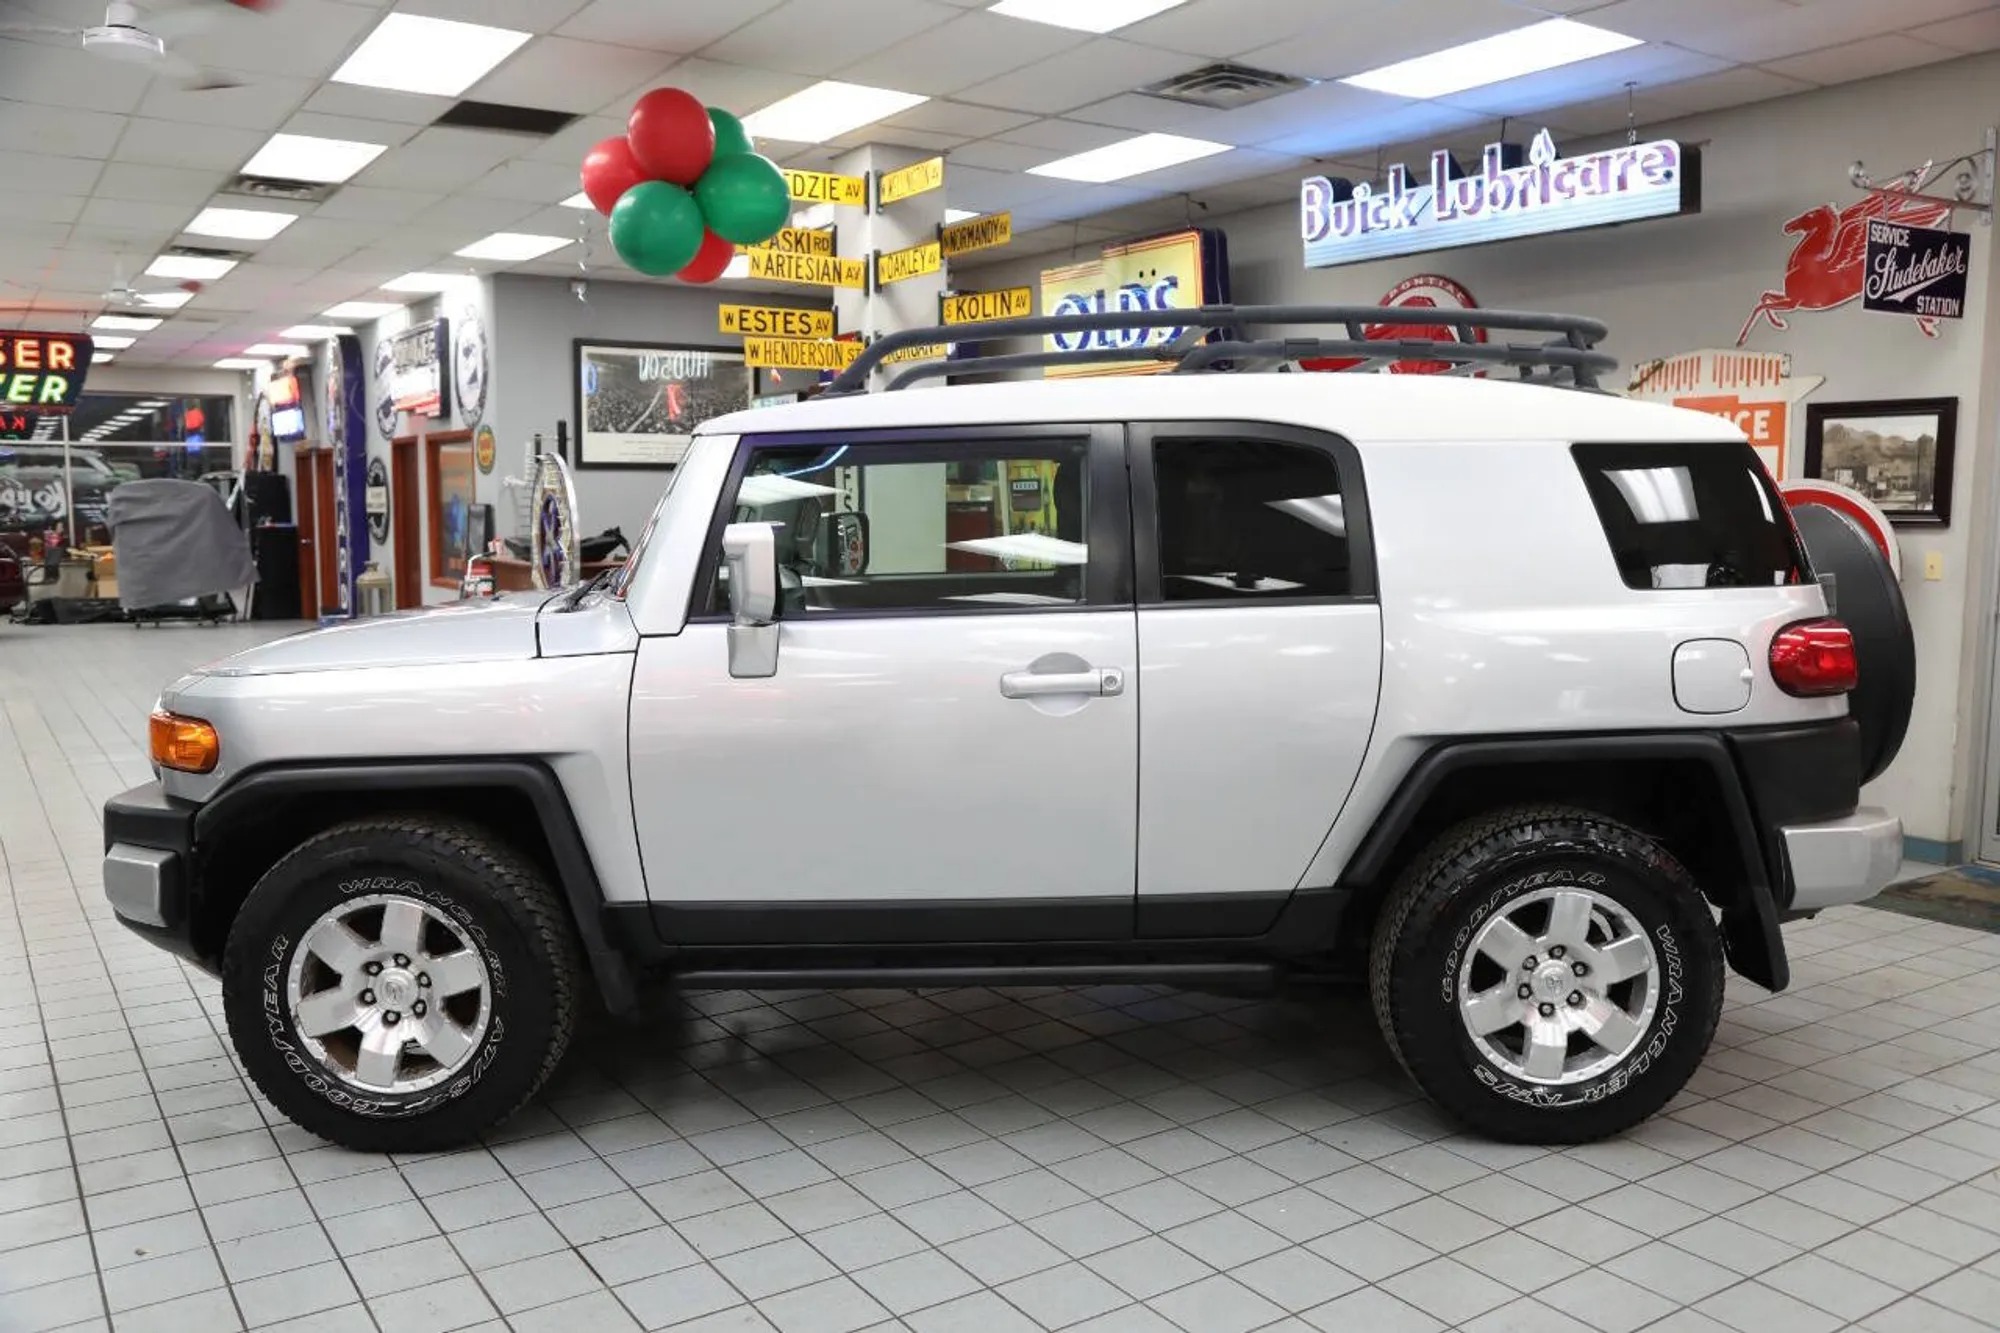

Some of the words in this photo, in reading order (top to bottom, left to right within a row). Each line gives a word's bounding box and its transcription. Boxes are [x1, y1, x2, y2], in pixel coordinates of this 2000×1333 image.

[784, 173, 840, 201] DZIE
[845, 184, 861, 197] AV
[1301, 162, 1420, 242] Buick
[1431, 128, 1677, 221] Lubricare
[768, 230, 810, 254] ASKI
[814, 237, 830, 251] RD
[1870, 225, 1911, 247] SERVICE
[752, 255, 760, 270] N
[764, 254, 842, 283] ARTESIAN
[846, 267, 861, 280] AV
[888, 248, 926, 279] OAKLEY
[1866, 242, 1966, 299] Studebaker
[1388, 277, 1466, 300] PONTIAC
[956, 292, 1012, 321] KOLIN
[1016, 294, 1027, 308] AV
[1917, 296, 1960, 315] STATION
[724, 312, 734, 326] W
[739, 309, 812, 334] ESTES
[815, 318, 829, 332] AV
[749, 344, 760, 359] W
[764, 341, 844, 366] HENDERSON
[1440, 870, 1608, 1003] GOODYEAR
[262, 933, 381, 1115] GOODYEAR
[1583, 925, 1683, 1103] WRANGLER
